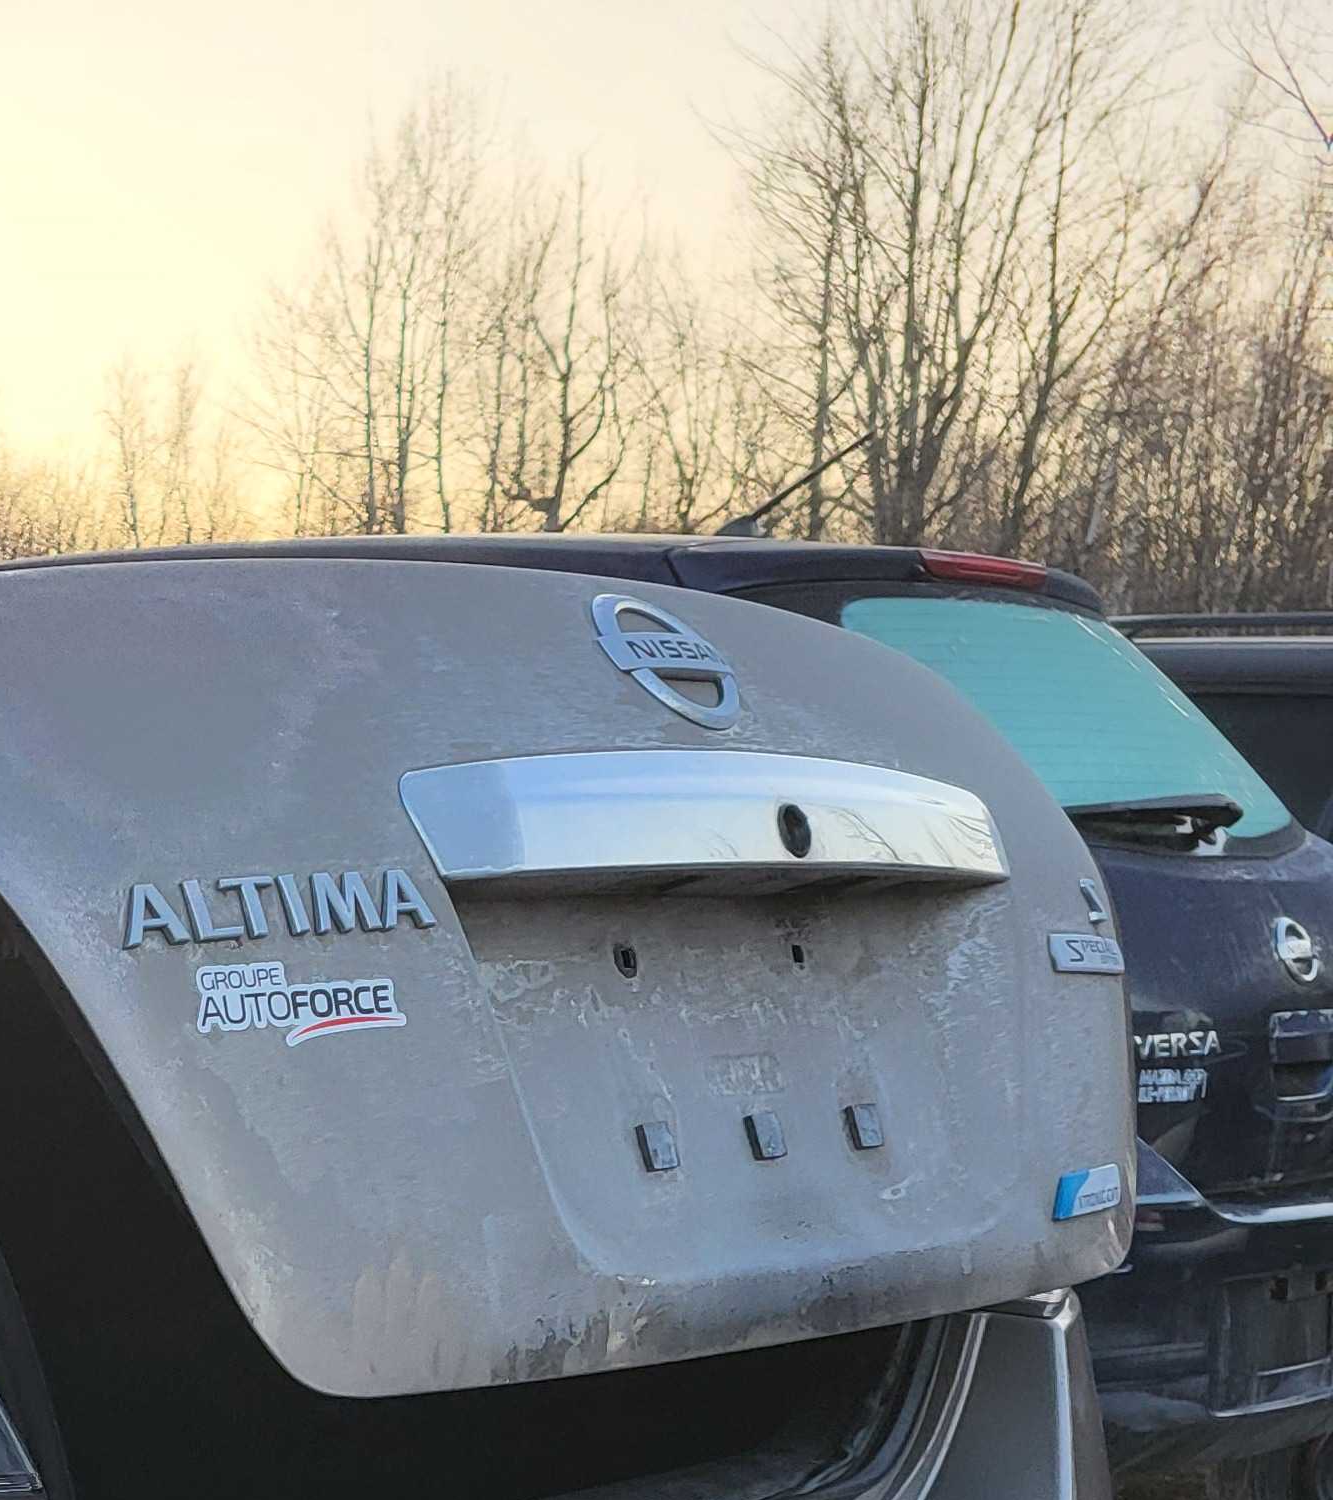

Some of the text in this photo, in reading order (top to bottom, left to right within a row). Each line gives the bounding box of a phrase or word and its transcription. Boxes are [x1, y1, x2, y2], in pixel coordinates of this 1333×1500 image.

[123, 869, 438, 950] ALTIMA
[200, 967, 282, 991] GROUPE
[201, 985, 393, 1027] AUTOFORCE
[1134, 1030, 1221, 1058] VERSA
